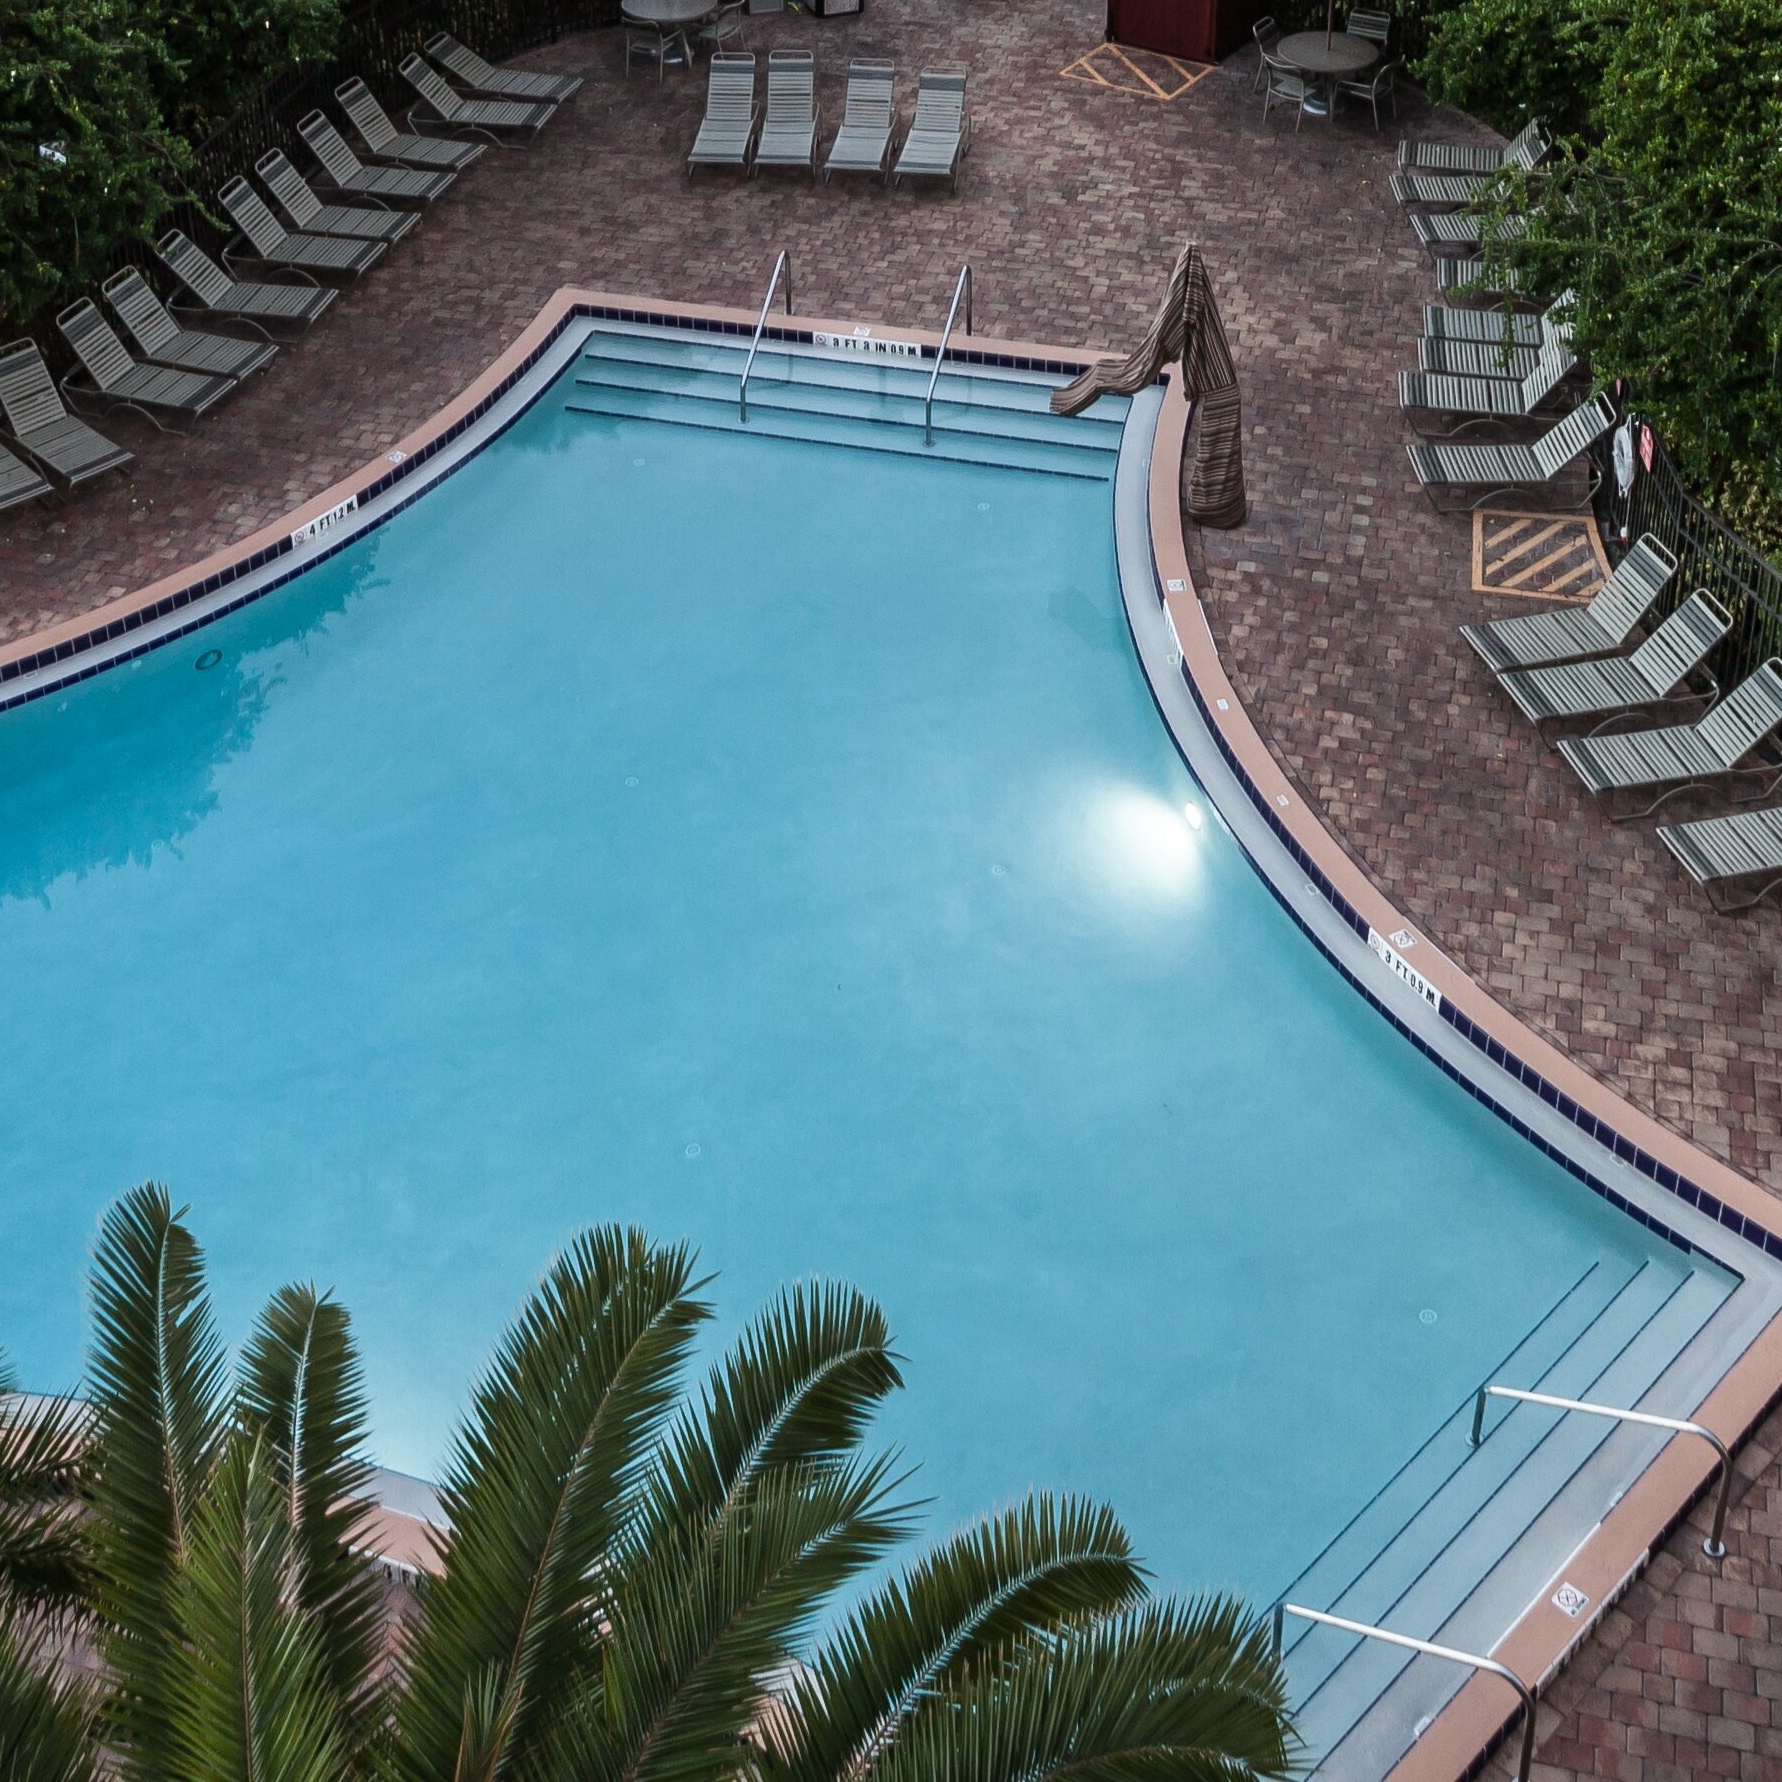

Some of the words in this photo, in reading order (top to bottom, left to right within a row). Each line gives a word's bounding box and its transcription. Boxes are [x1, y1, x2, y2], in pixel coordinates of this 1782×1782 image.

[832, 337, 839, 347] 3
[844, 338, 857, 349] FT
[863, 341, 870, 351] 3
[875, 342, 887, 353] IN
[309, 524, 316, 535] 4
[1385, 950, 1392, 964] 3
[1410, 974, 1424, 995] 0.9
